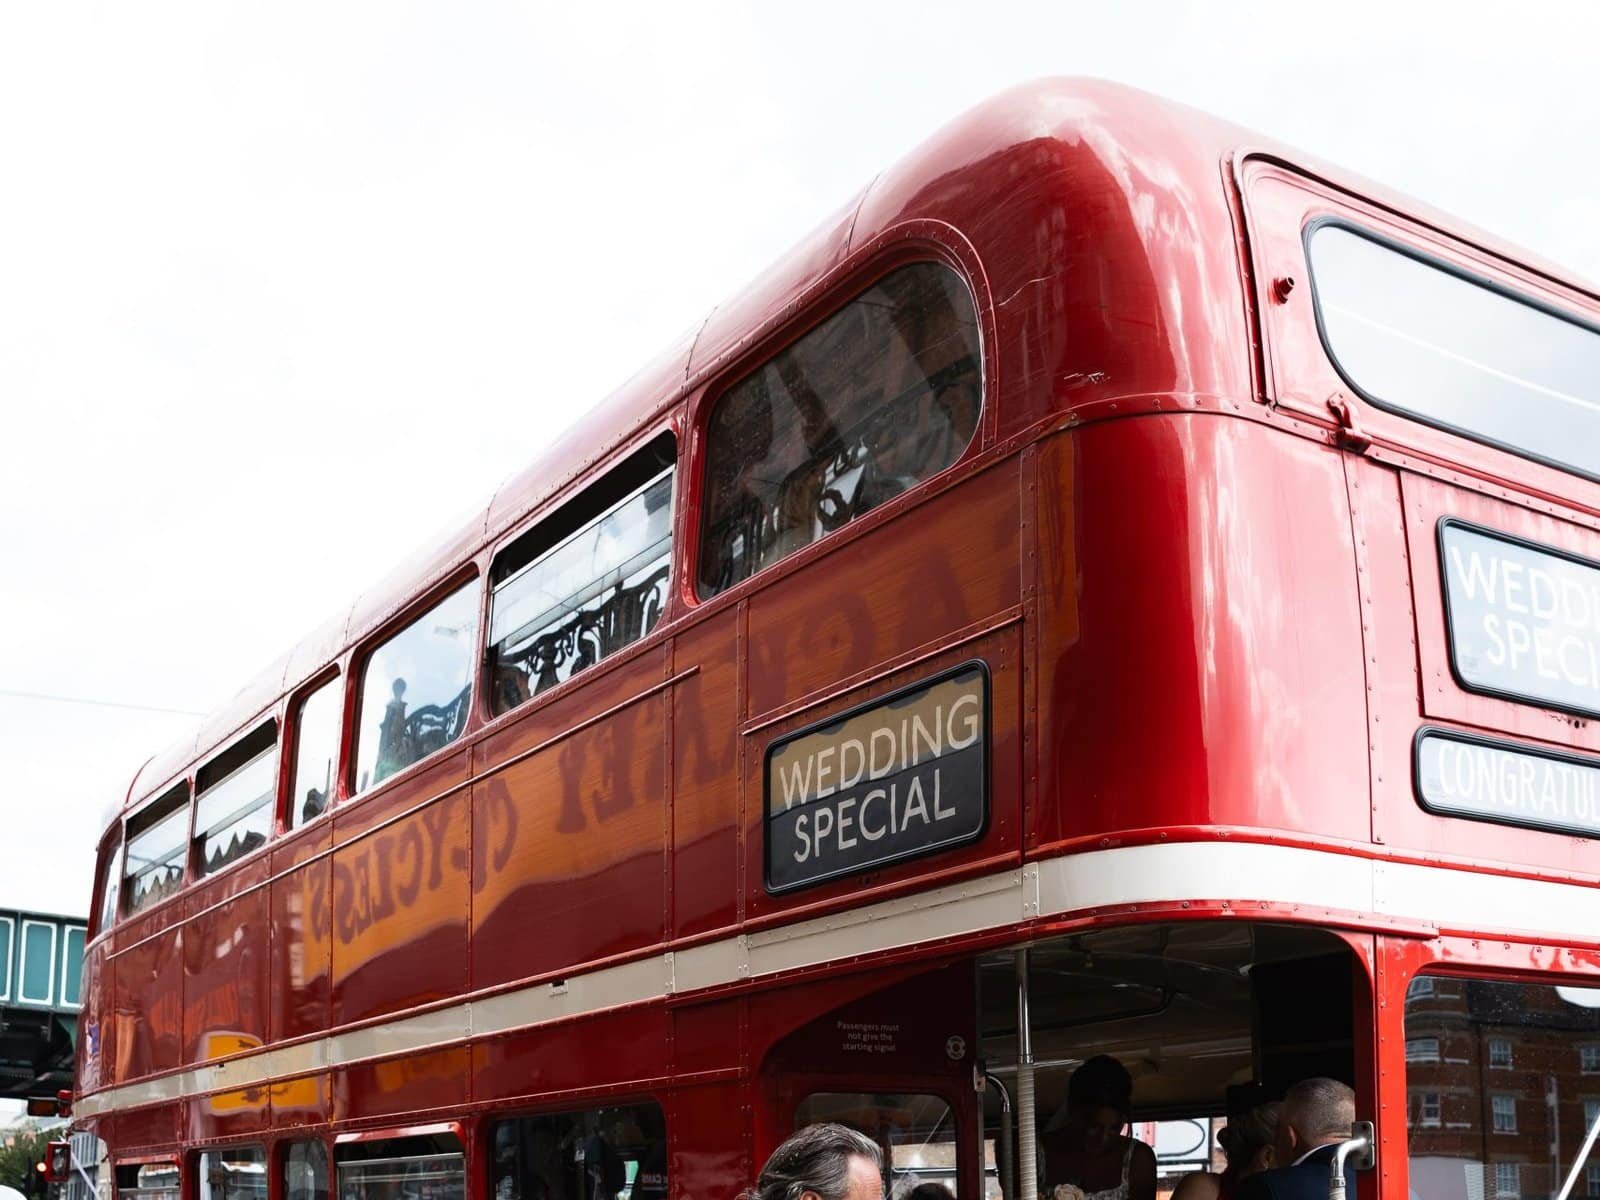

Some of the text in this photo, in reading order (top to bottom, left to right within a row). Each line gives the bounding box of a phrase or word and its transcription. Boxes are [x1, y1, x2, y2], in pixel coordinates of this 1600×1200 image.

[1450, 545, 1600, 632] WEDDI
[1483, 613, 1599, 690] SPECI
[780, 694, 979, 810] WEDDING
[1438, 742, 1600, 822] CONGRATUL
[793, 767, 956, 863] SPECIAL
[837, 1021, 899, 1032] Passengers must
[842, 1043, 873, 1053] starting
[848, 1032, 893, 1042] not give the
